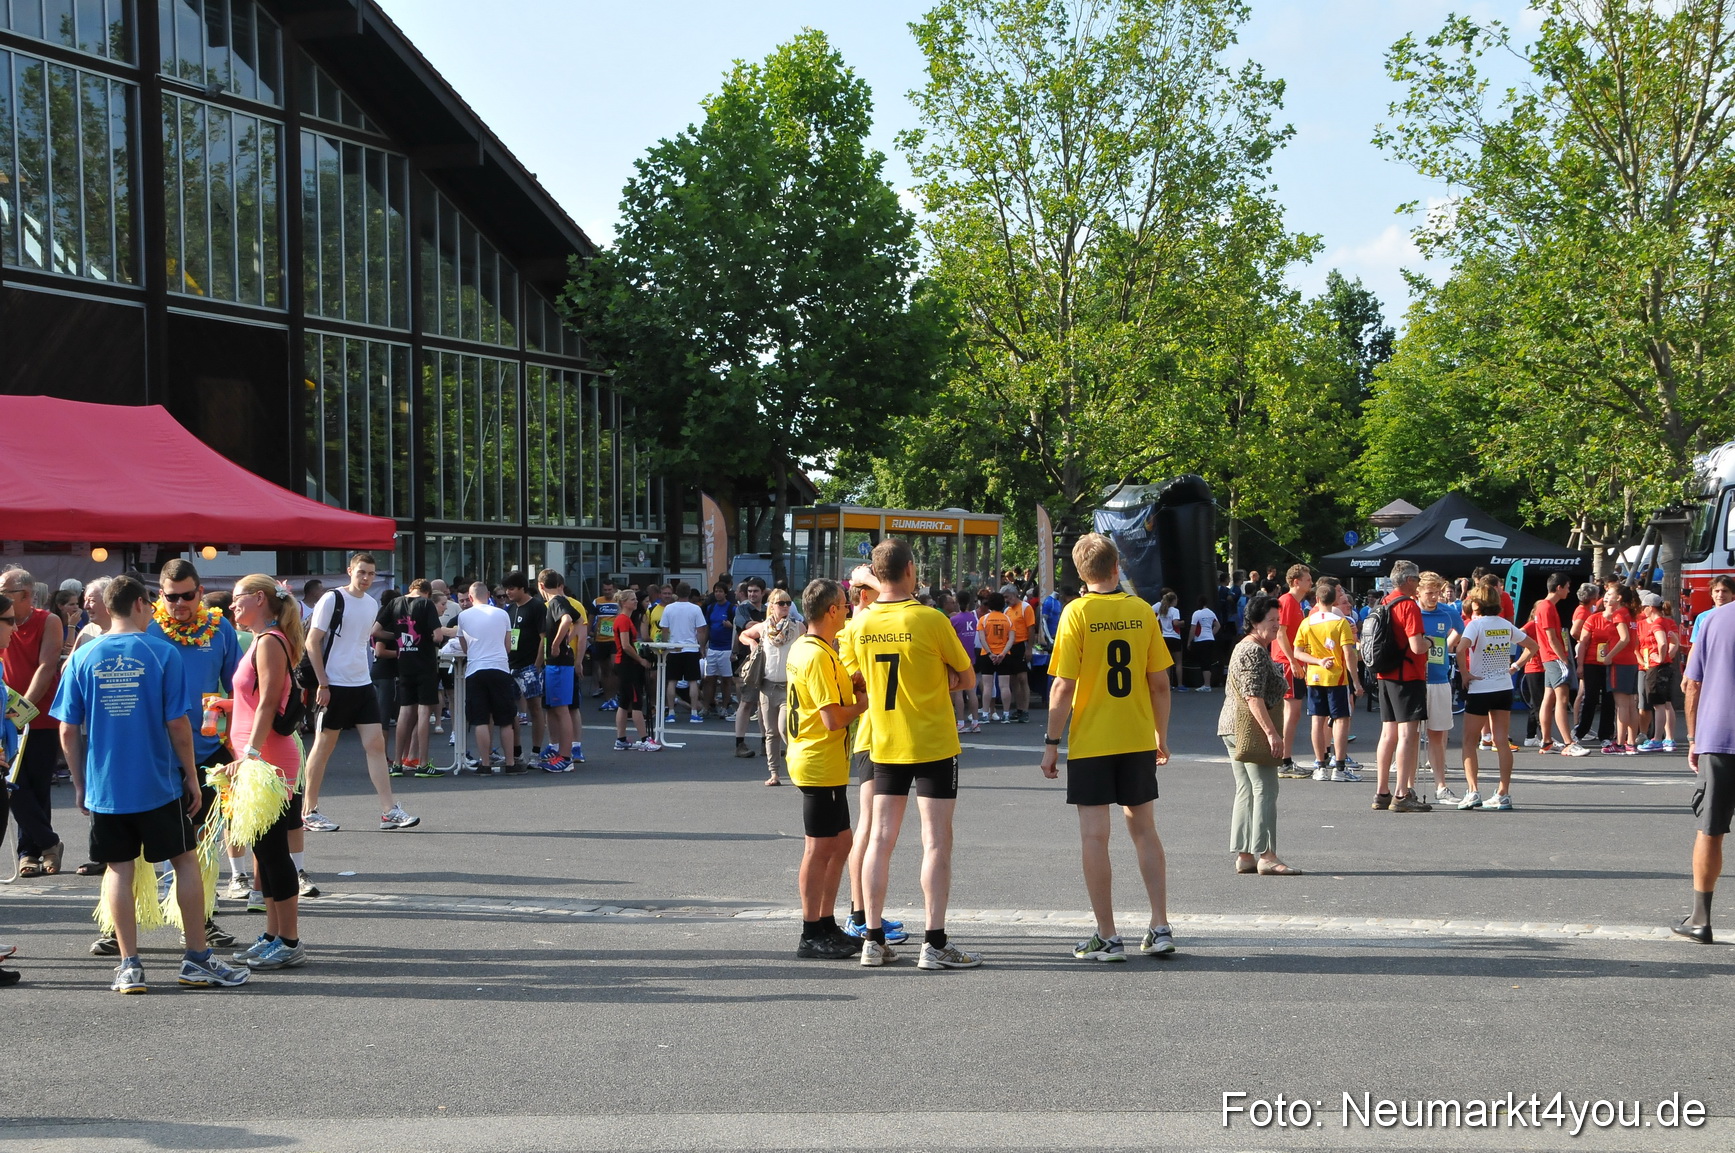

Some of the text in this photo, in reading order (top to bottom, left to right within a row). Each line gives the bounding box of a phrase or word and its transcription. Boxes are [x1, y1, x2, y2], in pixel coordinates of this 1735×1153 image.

[1350, 558, 1381, 569] bergamont
[1490, 555, 1582, 567] bergamont
[966, 620, 974, 631] K
[1089, 619, 1143, 633] SPANGLER
[859, 632, 912, 645] SPANGLER
[1107, 639, 1132, 698] 8
[875, 653, 900, 711] 7
